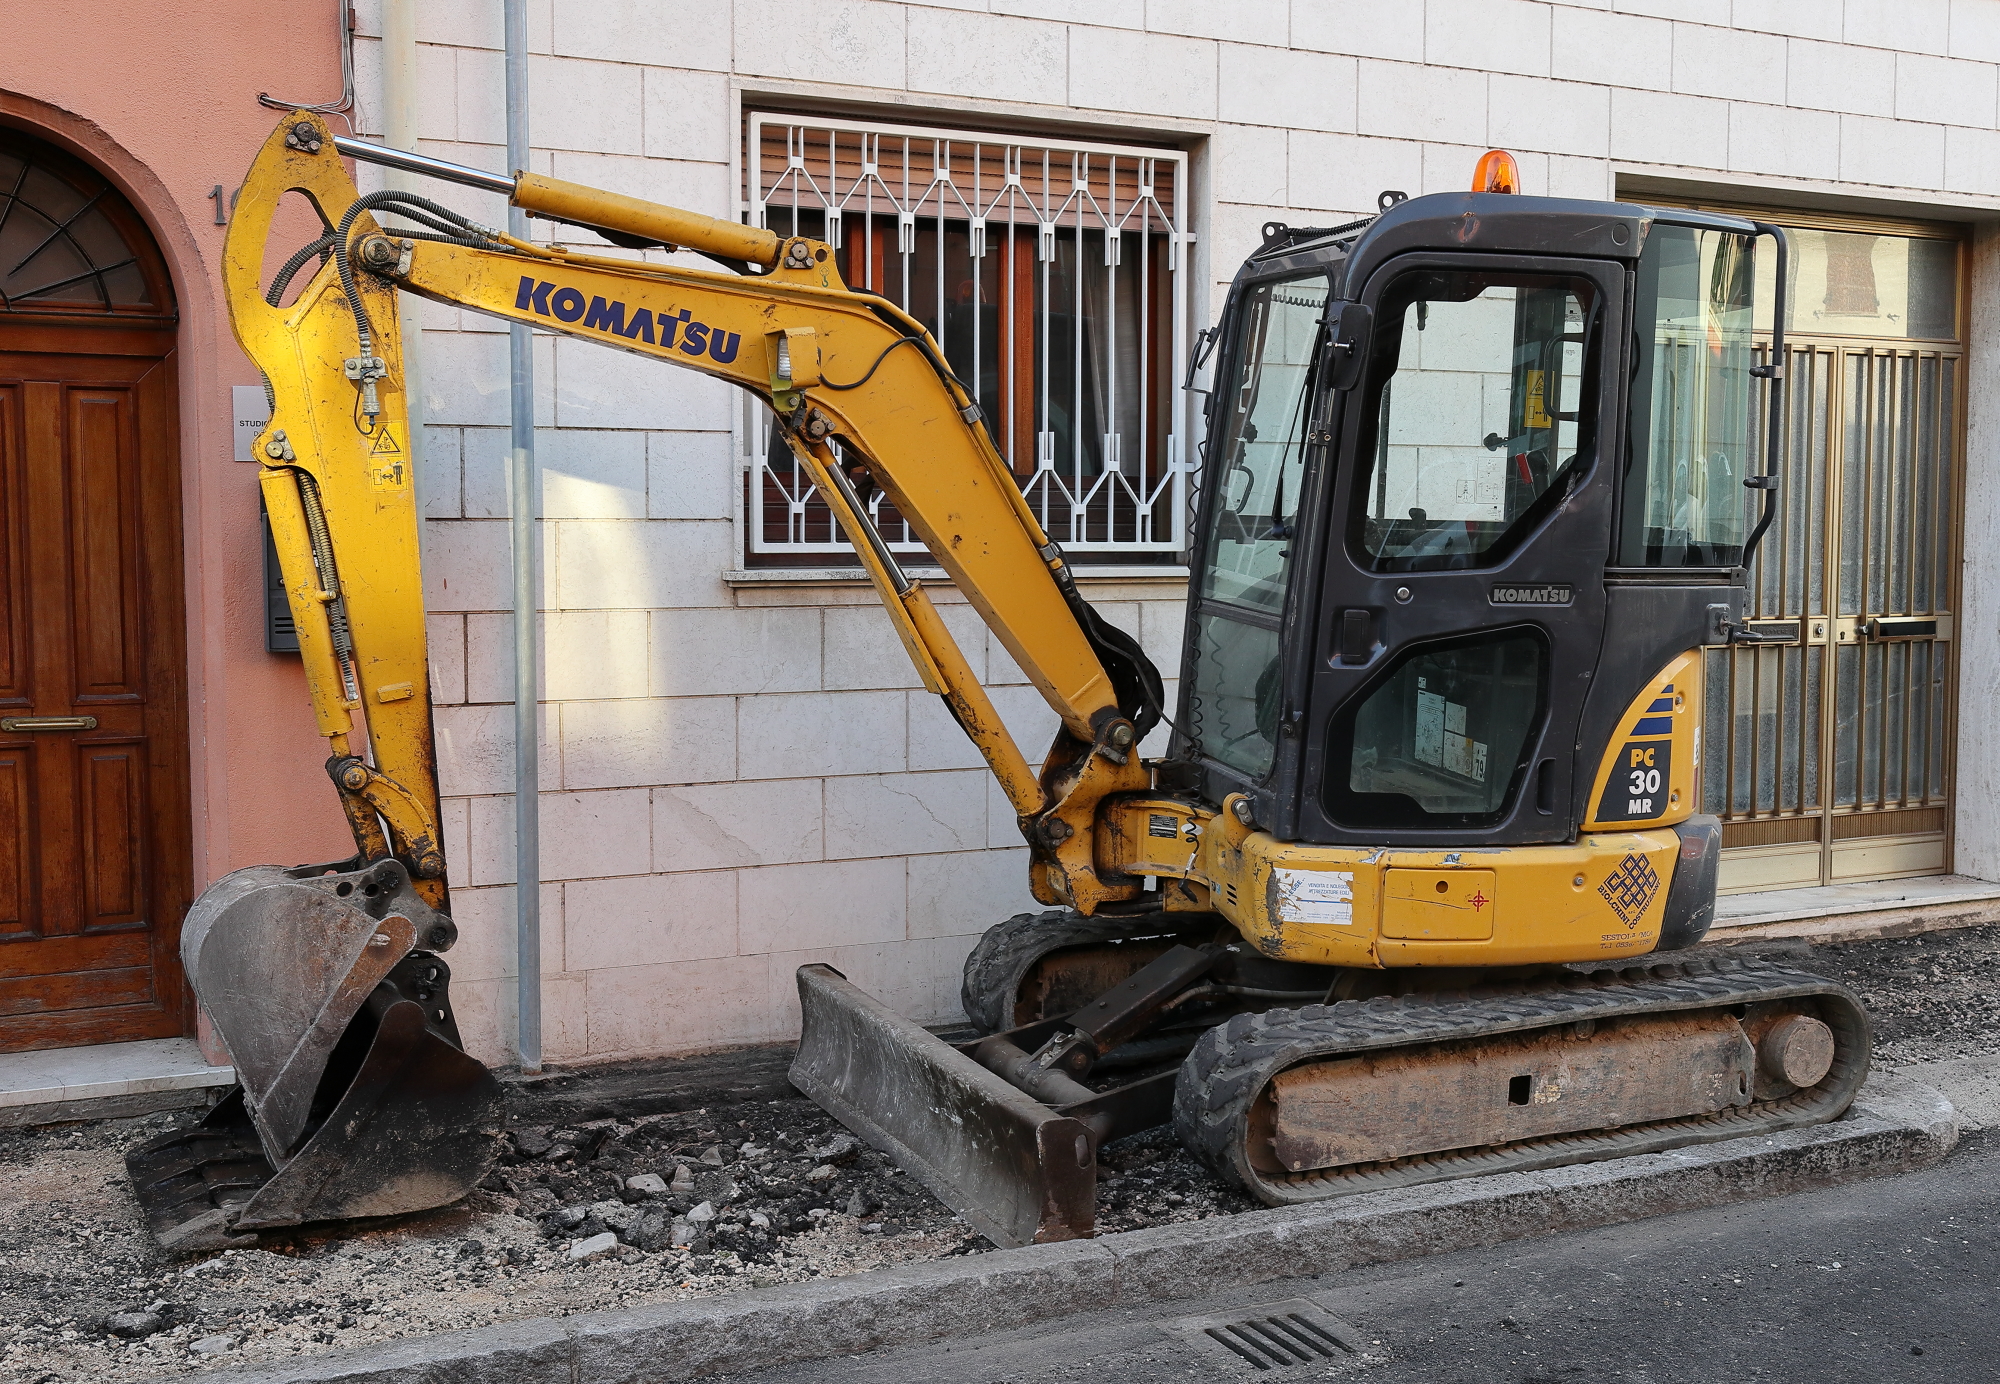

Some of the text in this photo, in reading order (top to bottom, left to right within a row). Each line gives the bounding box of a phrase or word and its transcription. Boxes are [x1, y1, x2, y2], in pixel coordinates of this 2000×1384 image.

[208, 184, 240, 225] 1
[514, 275, 741, 364] KOMATSU
[1493, 585, 1570, 602] KOMATSU
[1630, 747, 1655, 768] PC
[1628, 768, 1661, 795] 30
[1627, 798, 1652, 815] MR
[1597, 884, 1630, 925] BIOLCHINI
